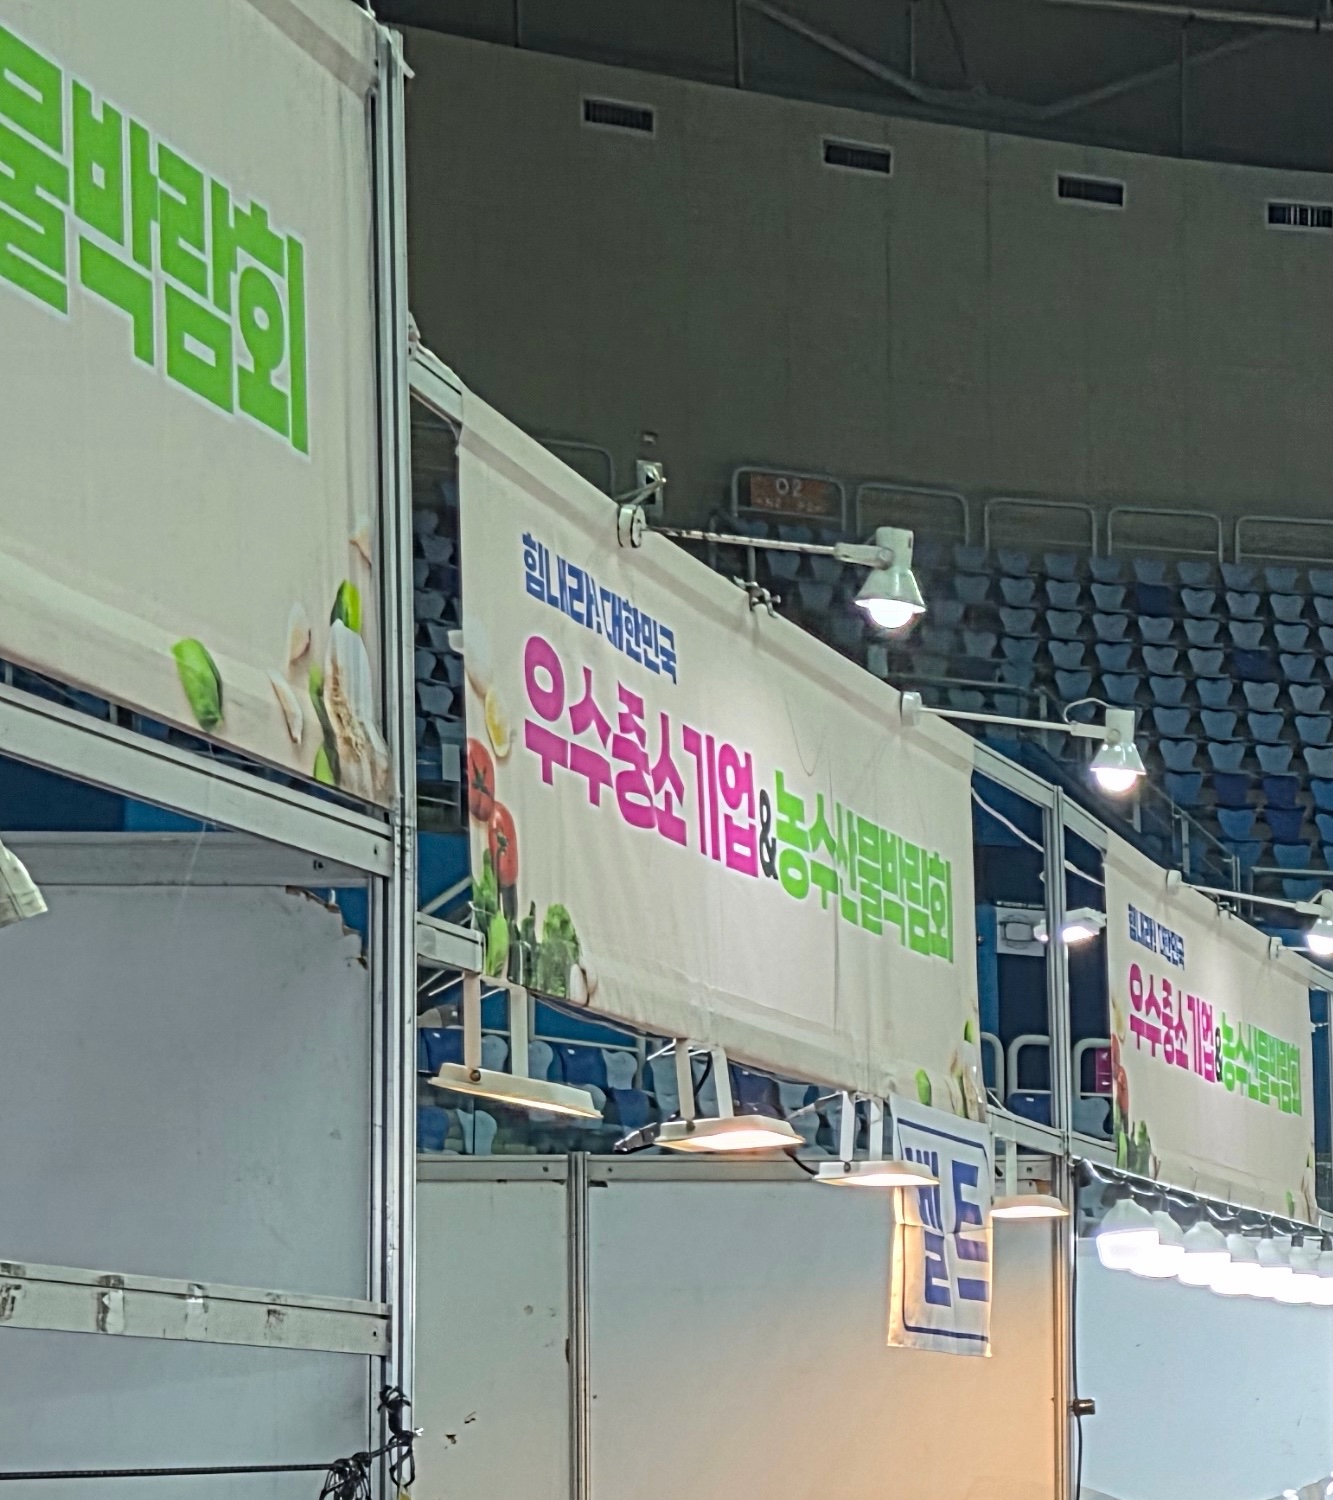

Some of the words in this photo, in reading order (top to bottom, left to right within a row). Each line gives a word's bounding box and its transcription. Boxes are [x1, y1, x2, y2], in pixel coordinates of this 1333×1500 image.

[522, 532, 603, 634] 힘내라!
[600, 586, 678, 684] 대한민국
[523, 635, 955, 963] 우수중소기업&농수산물박람회
[1129, 963, 1303, 1116] 우수중소기업&농수산물박람회
